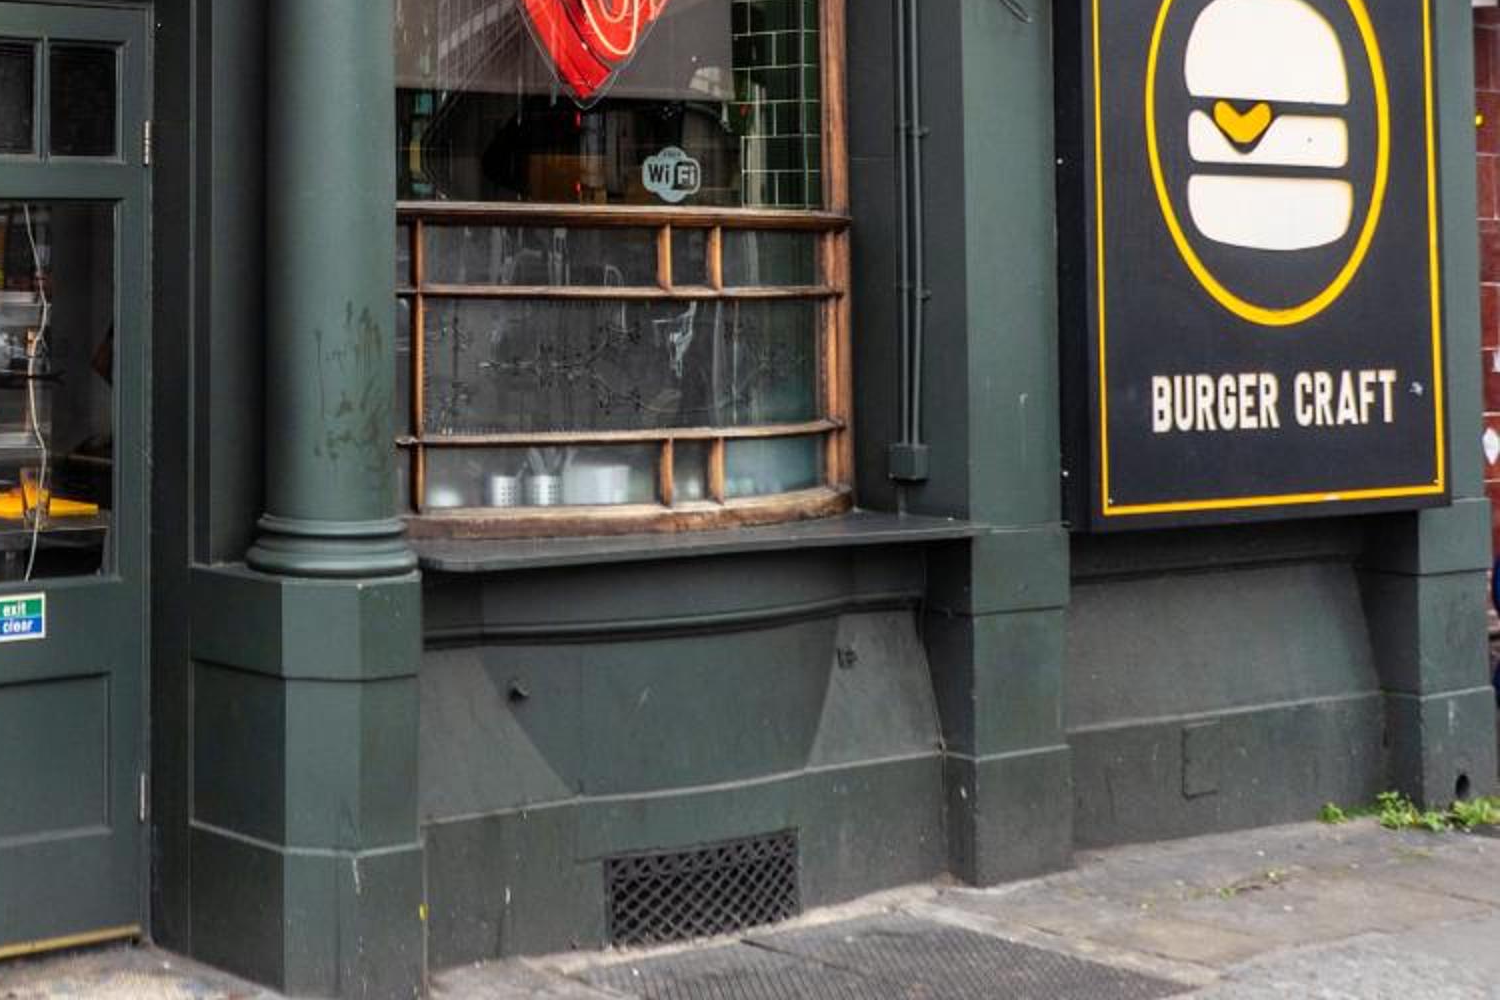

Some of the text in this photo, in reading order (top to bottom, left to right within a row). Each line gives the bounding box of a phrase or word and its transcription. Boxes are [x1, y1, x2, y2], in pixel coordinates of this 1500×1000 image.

[1151, 369, 1398, 433] BURGER CRAFT
[3, 600, 27, 617] exit
[3, 619, 34, 633] clear
